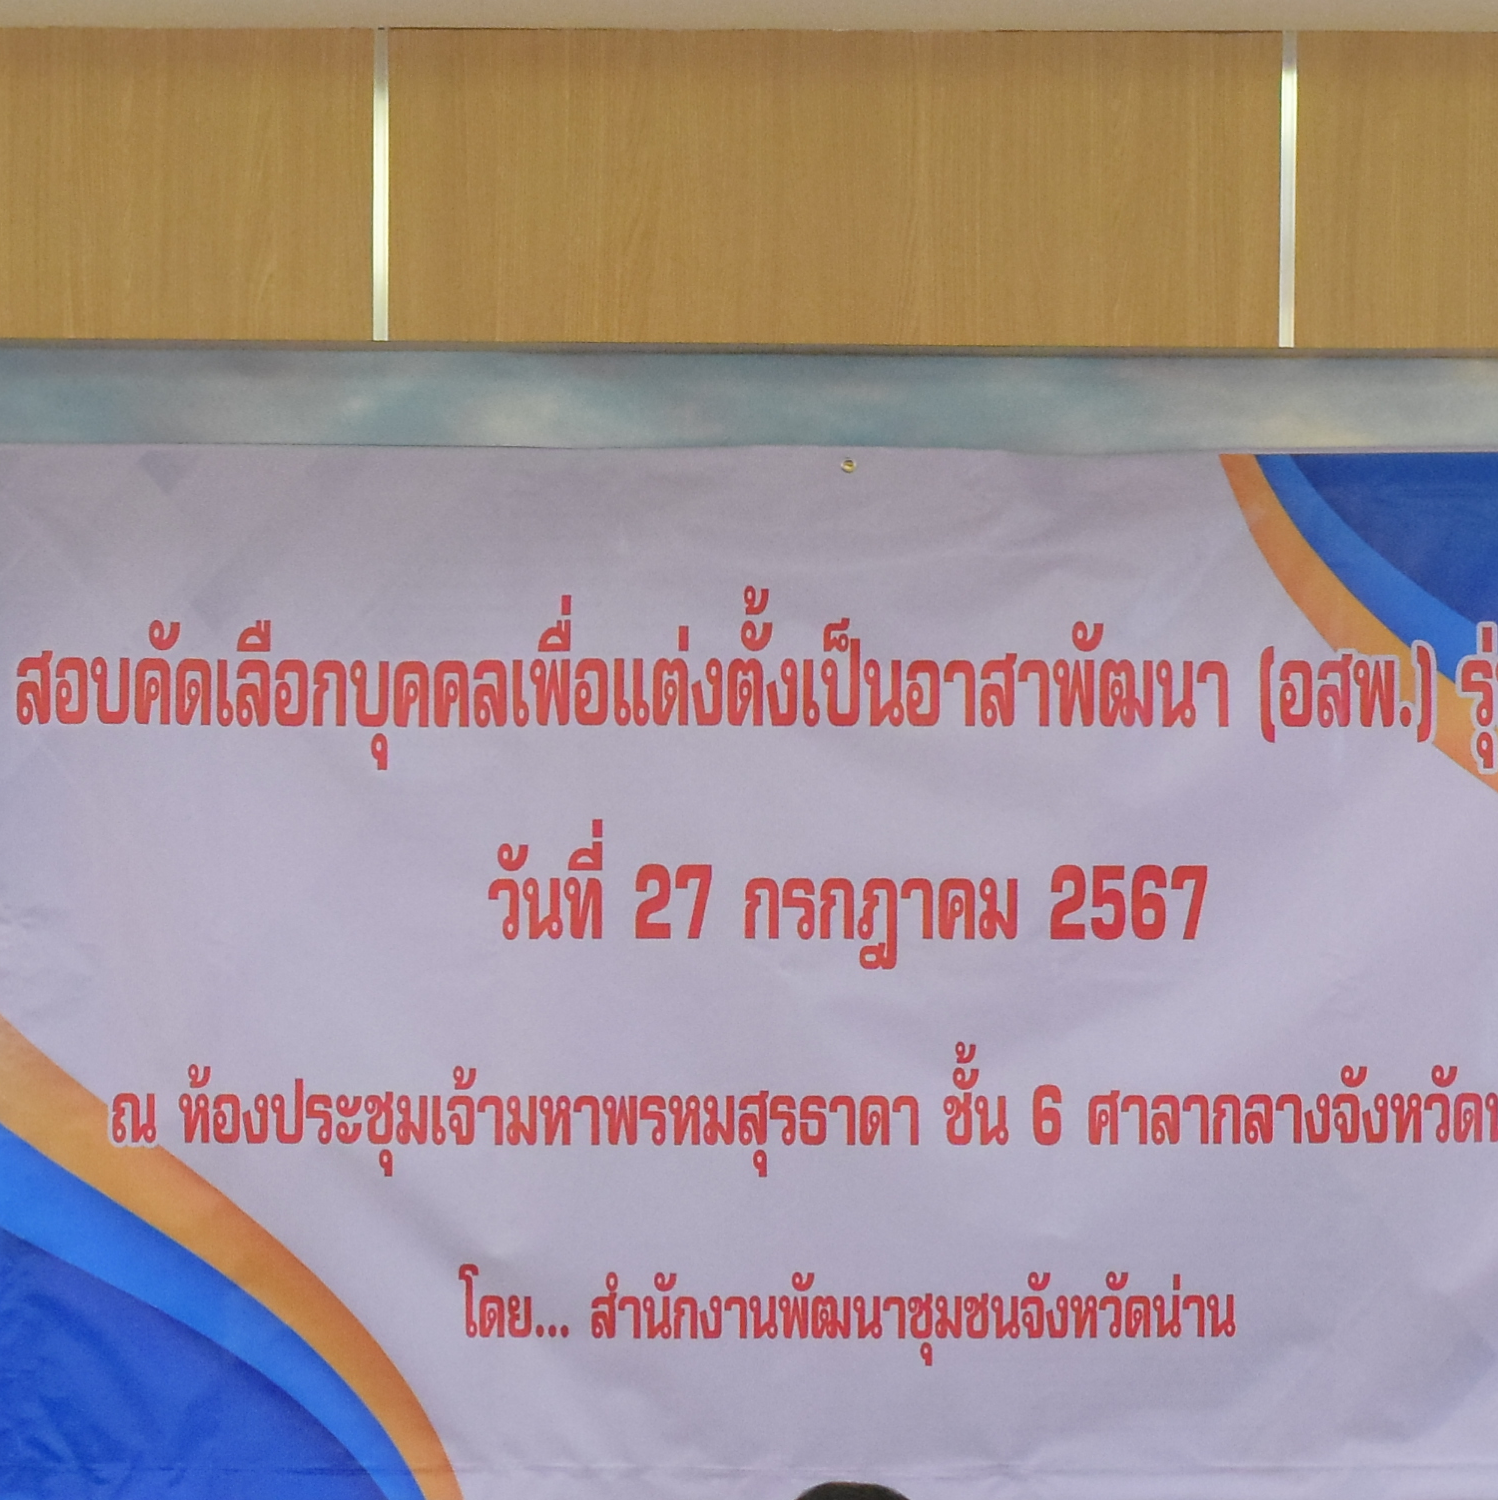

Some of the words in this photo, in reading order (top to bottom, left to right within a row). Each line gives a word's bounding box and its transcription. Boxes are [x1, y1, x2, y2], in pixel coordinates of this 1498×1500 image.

[15, 584, 1230, 771] สอบคัดเลือกบุคคลเพื่อแต่งตั้งเป็นอาสาพัฒนา
[1259, 645, 1433, 743] (อสพ.)
[487, 818, 604, 941] วันที่
[634, 863, 713, 940] 27
[743, 876, 1019, 971] กรกฎาคม
[1049, 864, 1209, 942] 2567
[111, 1091, 158, 1145] ณ
[178, 1063, 920, 1178] ห้องประชุมเจ้ามหาพรหมสุรธาดา
[943, 1040, 1010, 1146] ชั้น
[1031, 1083, 1063, 1147] 6
[457, 1263, 570, 1339] โดย...
[590, 1270, 1237, 1367] สำนักงานพัฒนาชุมชนจังหวัดน่าน
